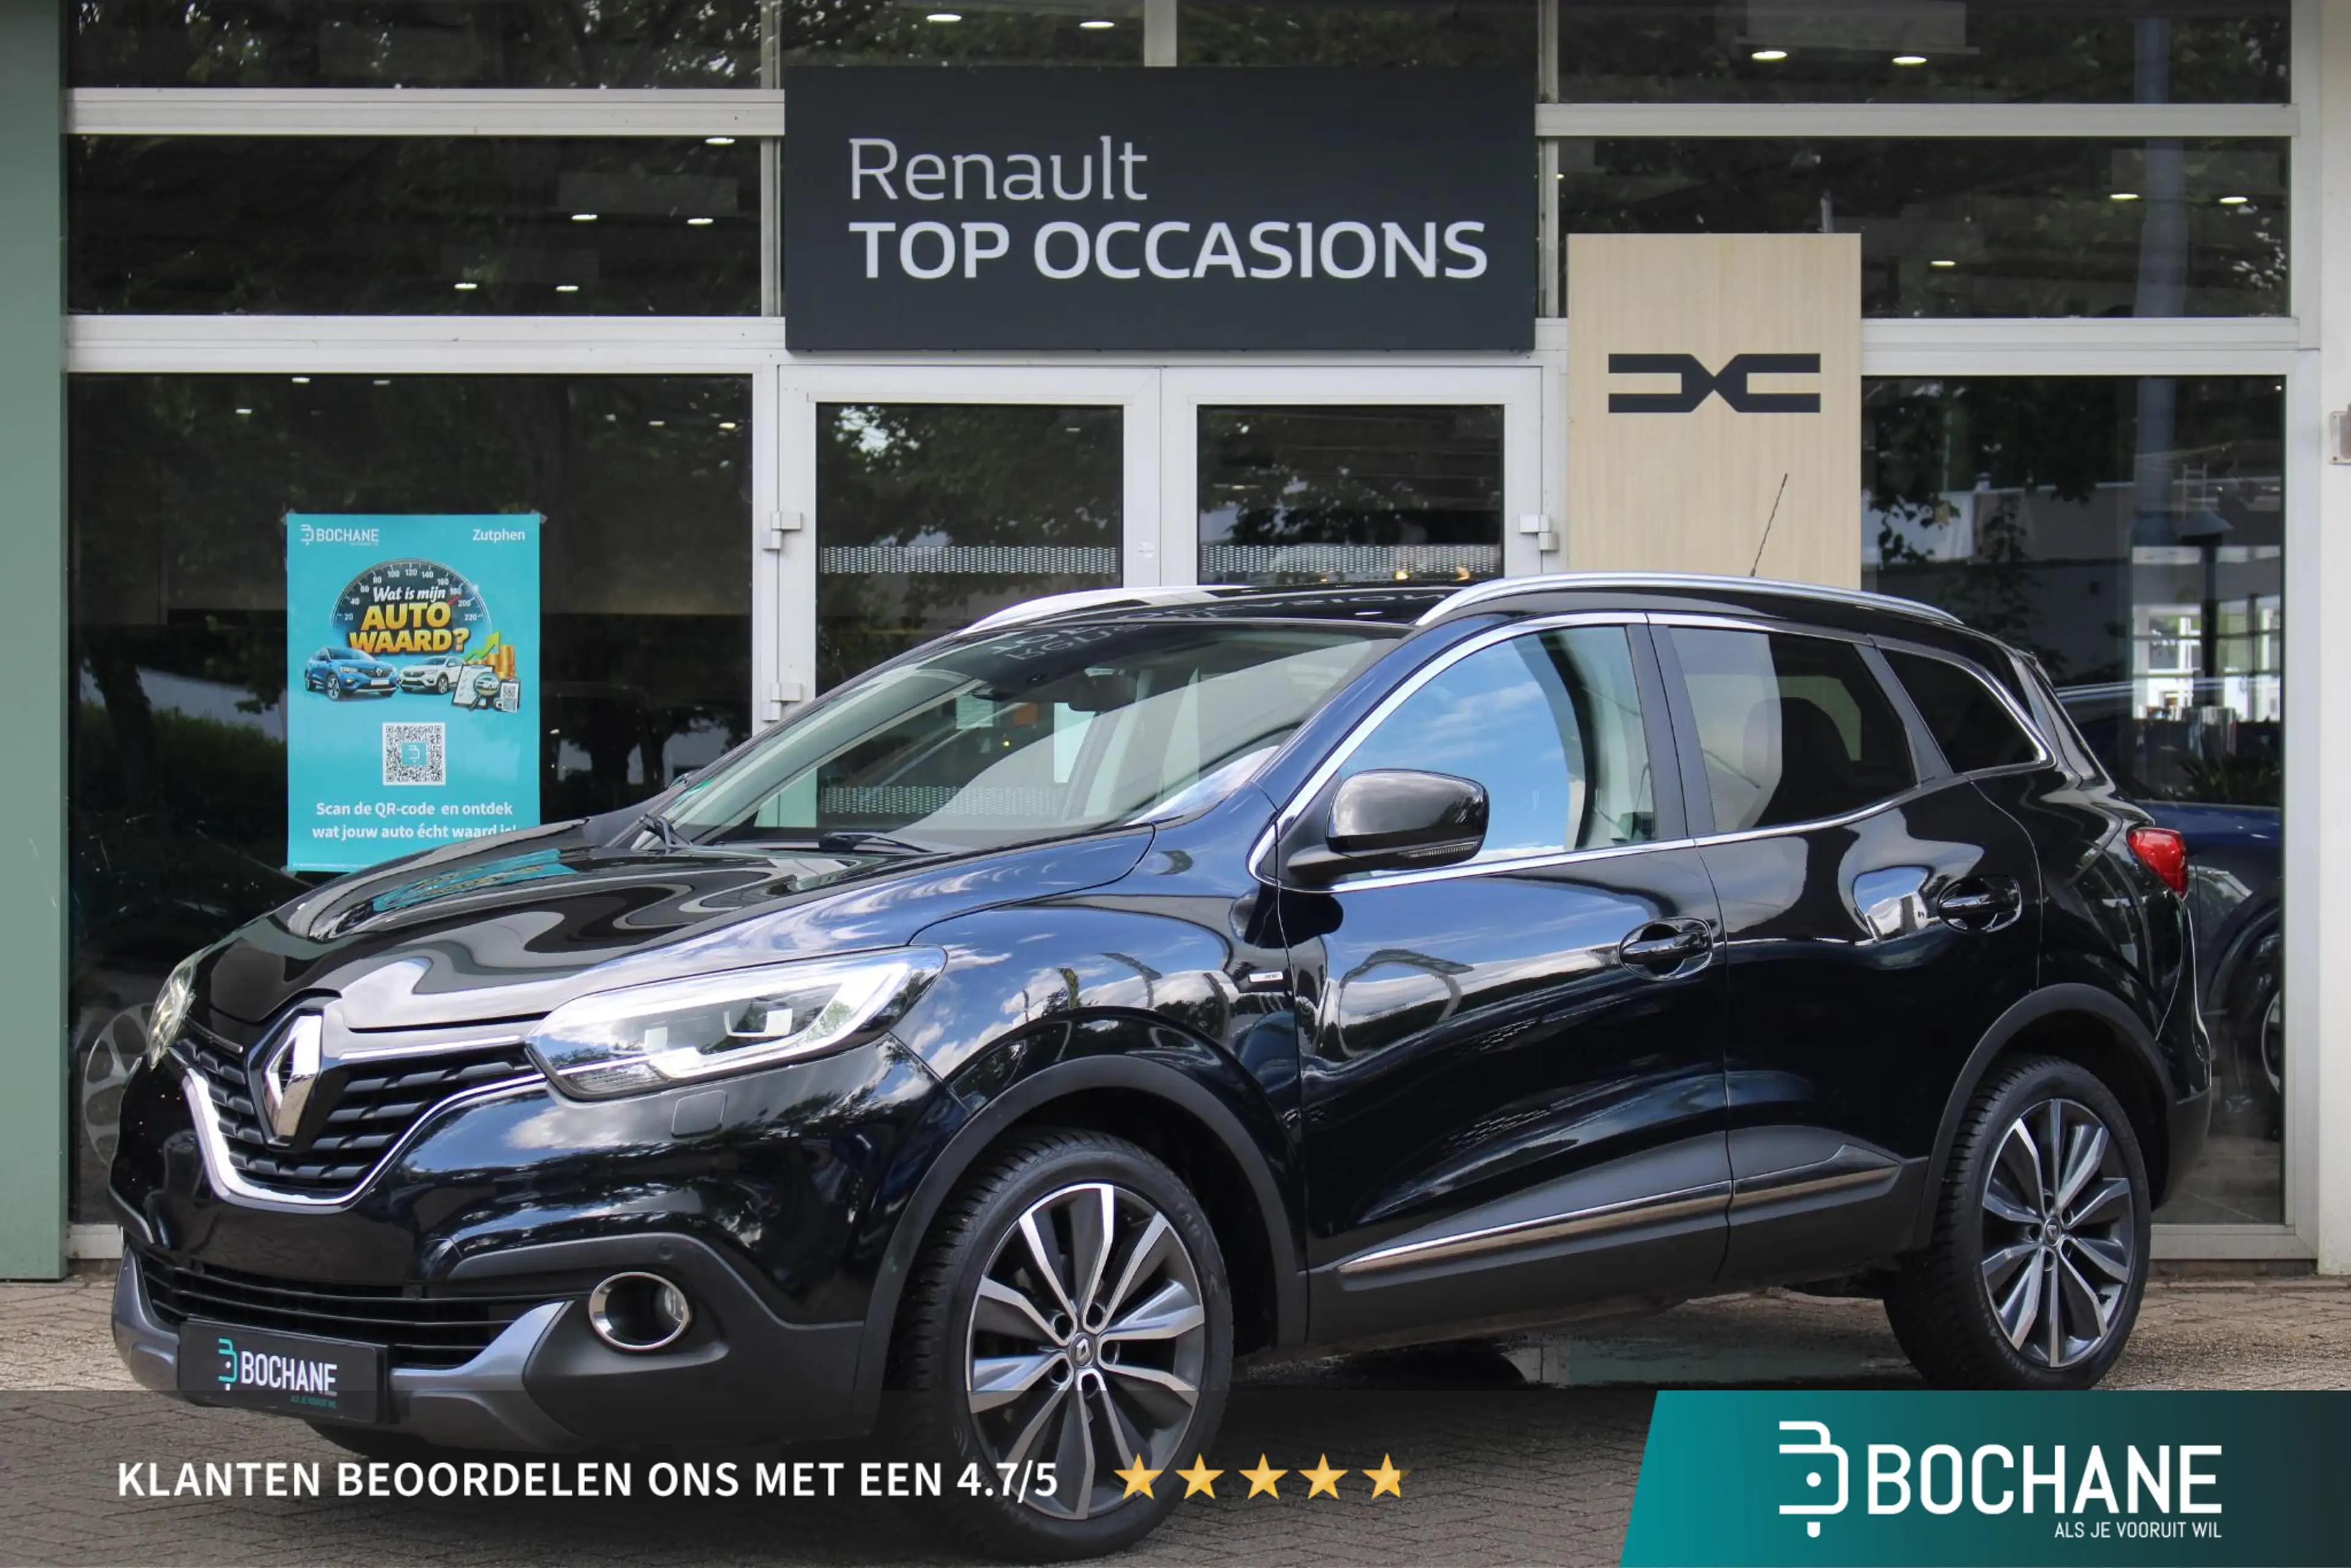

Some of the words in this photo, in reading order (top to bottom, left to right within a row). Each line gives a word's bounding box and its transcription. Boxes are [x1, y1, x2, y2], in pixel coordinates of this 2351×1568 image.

[849, 135, 1147, 201] Renault
[849, 221, 1010, 279] TOP
[1034, 221, 1488, 279] OCCASIONS
[316, 528, 379, 542] BOCHANE
[473, 529, 525, 544] Zutphen
[373, 586, 402, 602] Wat
[405, 587, 414, 599] is
[416, 586, 446, 602] mijn
[361, 602, 451, 631] AUTO
[349, 628, 469, 653] WAARD?
[316, 802, 350, 815] Scan
[354, 802, 372, 815] de
[375, 802, 435, 817] QR-code
[441, 806, 459, 815] en
[462, 802, 513, 815] ontdek
[312, 826, 339, 838] wat
[341, 825, 377, 841] jouw
[381, 826, 414, 838] auto
[417, 823, 449, 838] écht
[452, 824, 497, 838] waard
[241, 1351, 337, 1397] BOCHANE
